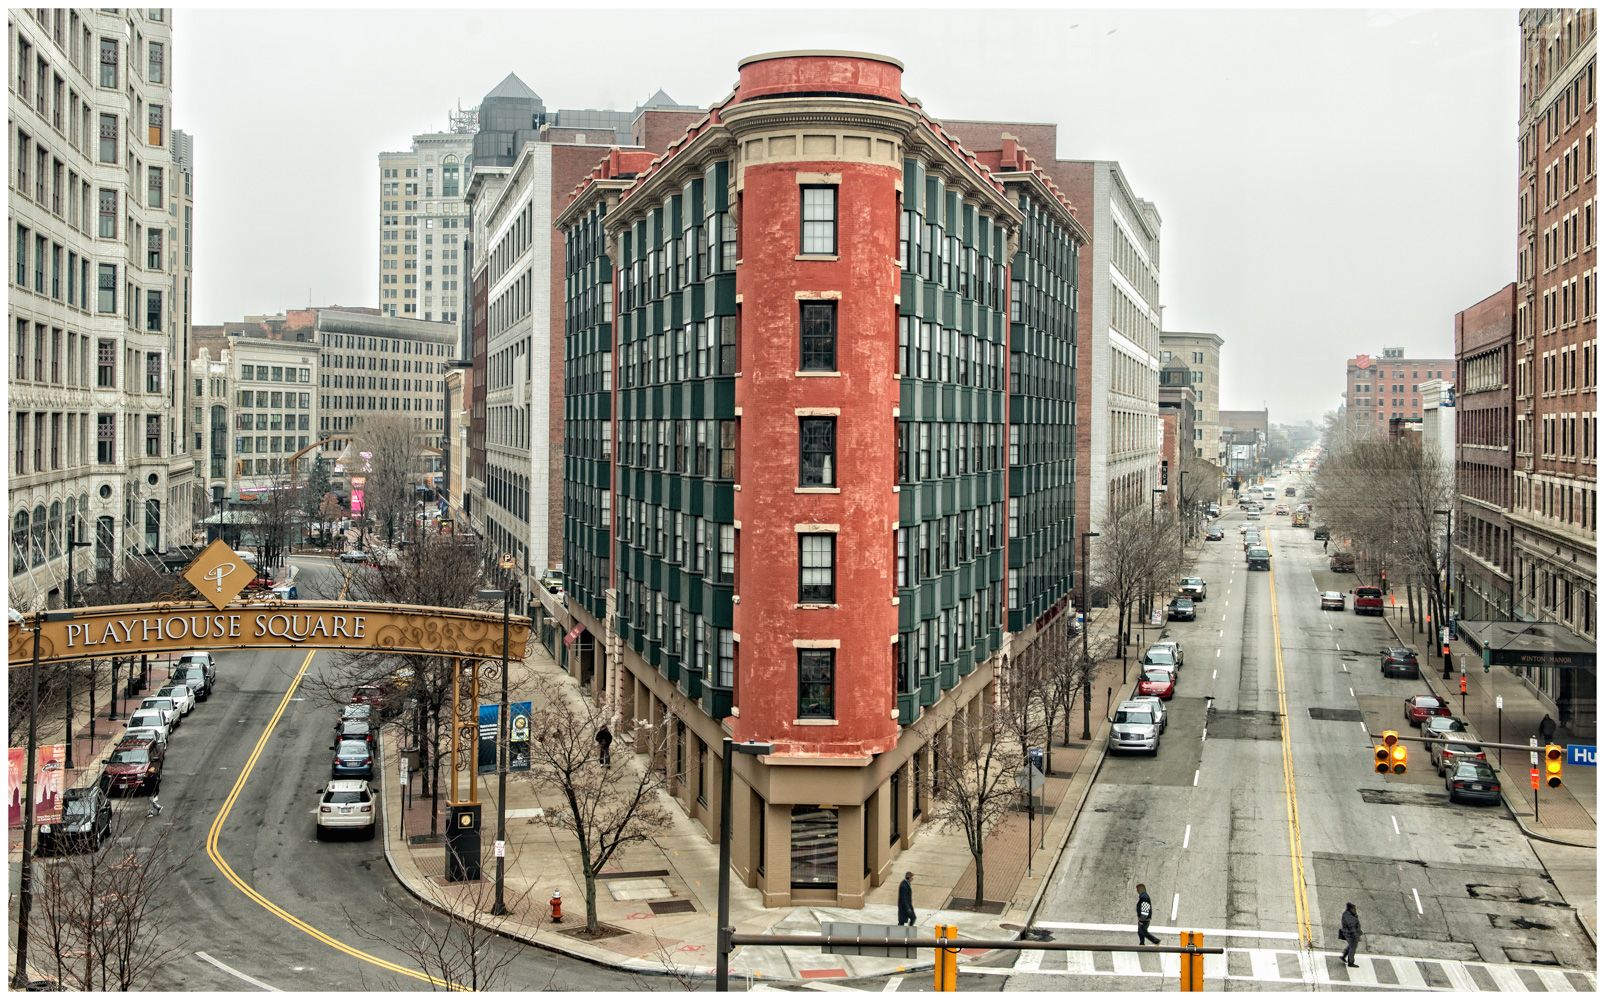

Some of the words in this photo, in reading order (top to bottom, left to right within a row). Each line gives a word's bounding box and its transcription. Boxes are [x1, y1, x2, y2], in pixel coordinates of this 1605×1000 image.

[505, 554, 511, 562] P
[66, 615, 241, 647] PLAYHOUSE
[254, 614, 367, 641] SQUARE
